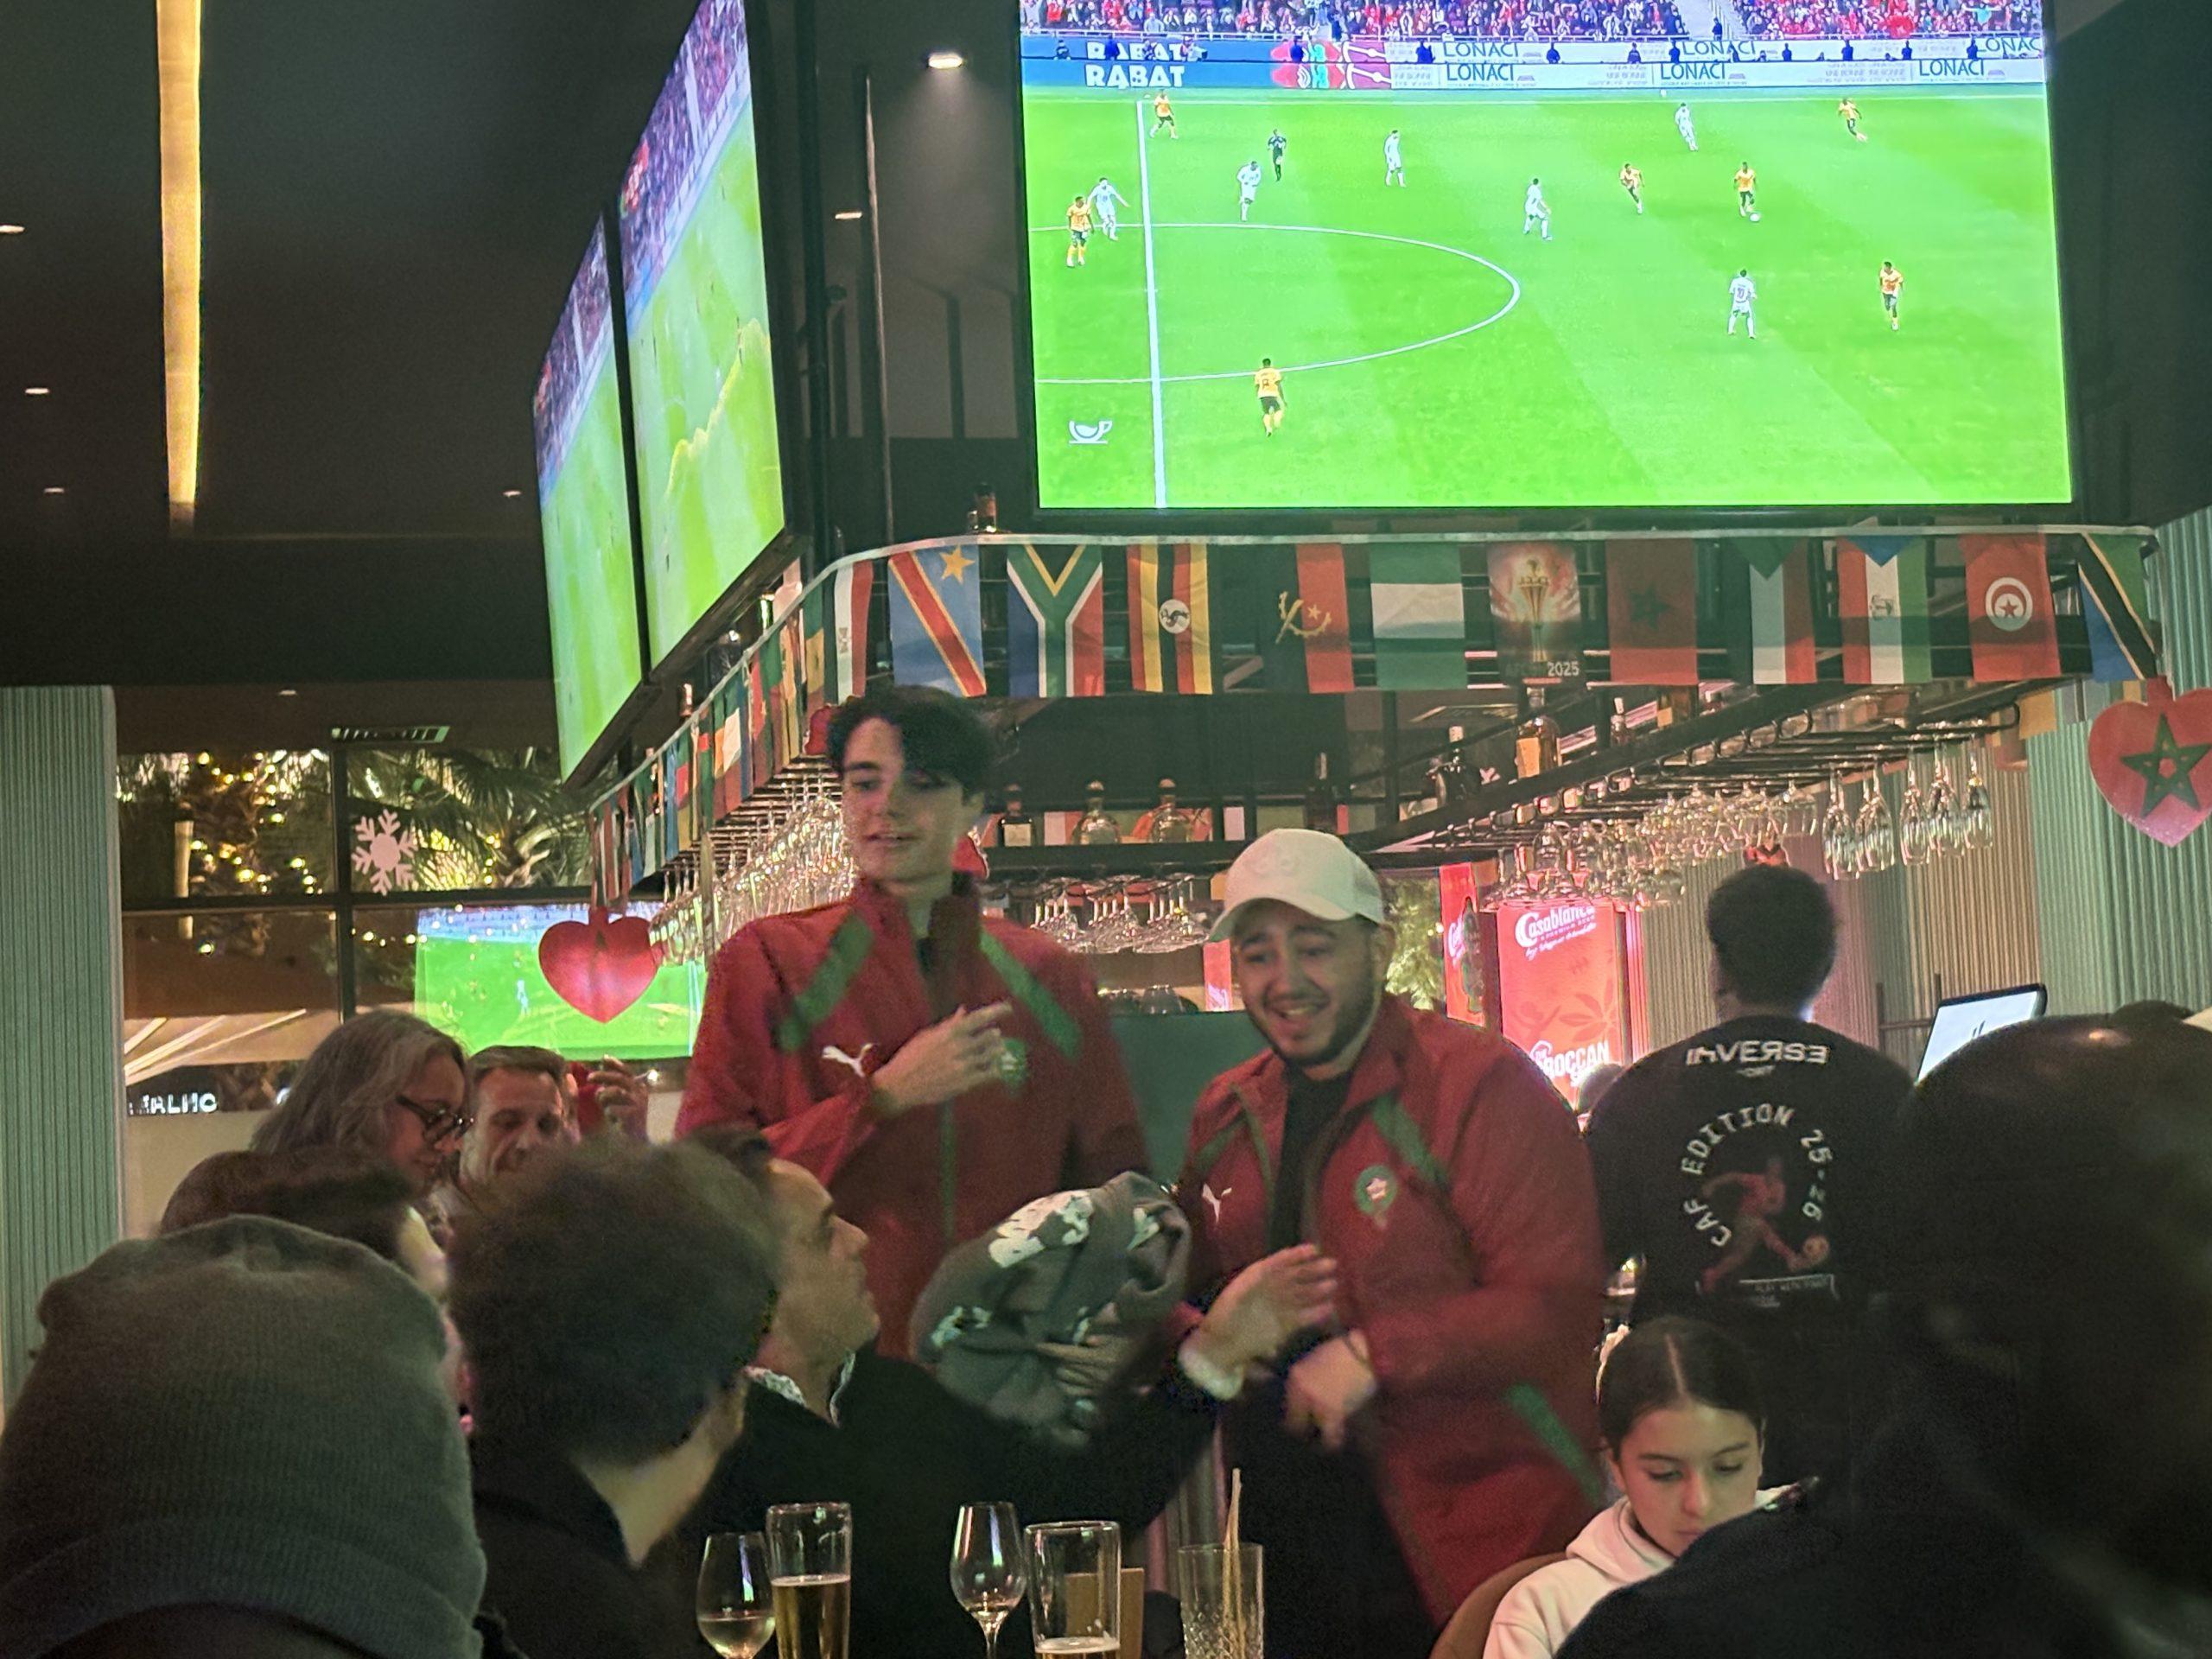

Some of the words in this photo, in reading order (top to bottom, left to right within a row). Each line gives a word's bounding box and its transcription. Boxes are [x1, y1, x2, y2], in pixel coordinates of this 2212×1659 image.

[1442, 42, 1519, 57] LONACI
[1085, 64, 1185, 88] RABAT
[1446, 63, 1514, 81] LONACI
[1661, 62, 1726, 79] LONACI
[1919, 59, 1985, 76] LONACI
[1548, 661, 1580, 677] 2025
[1681, 1103, 1796, 1175] EDITION
[1683, 1198, 1732, 1248] CAF
